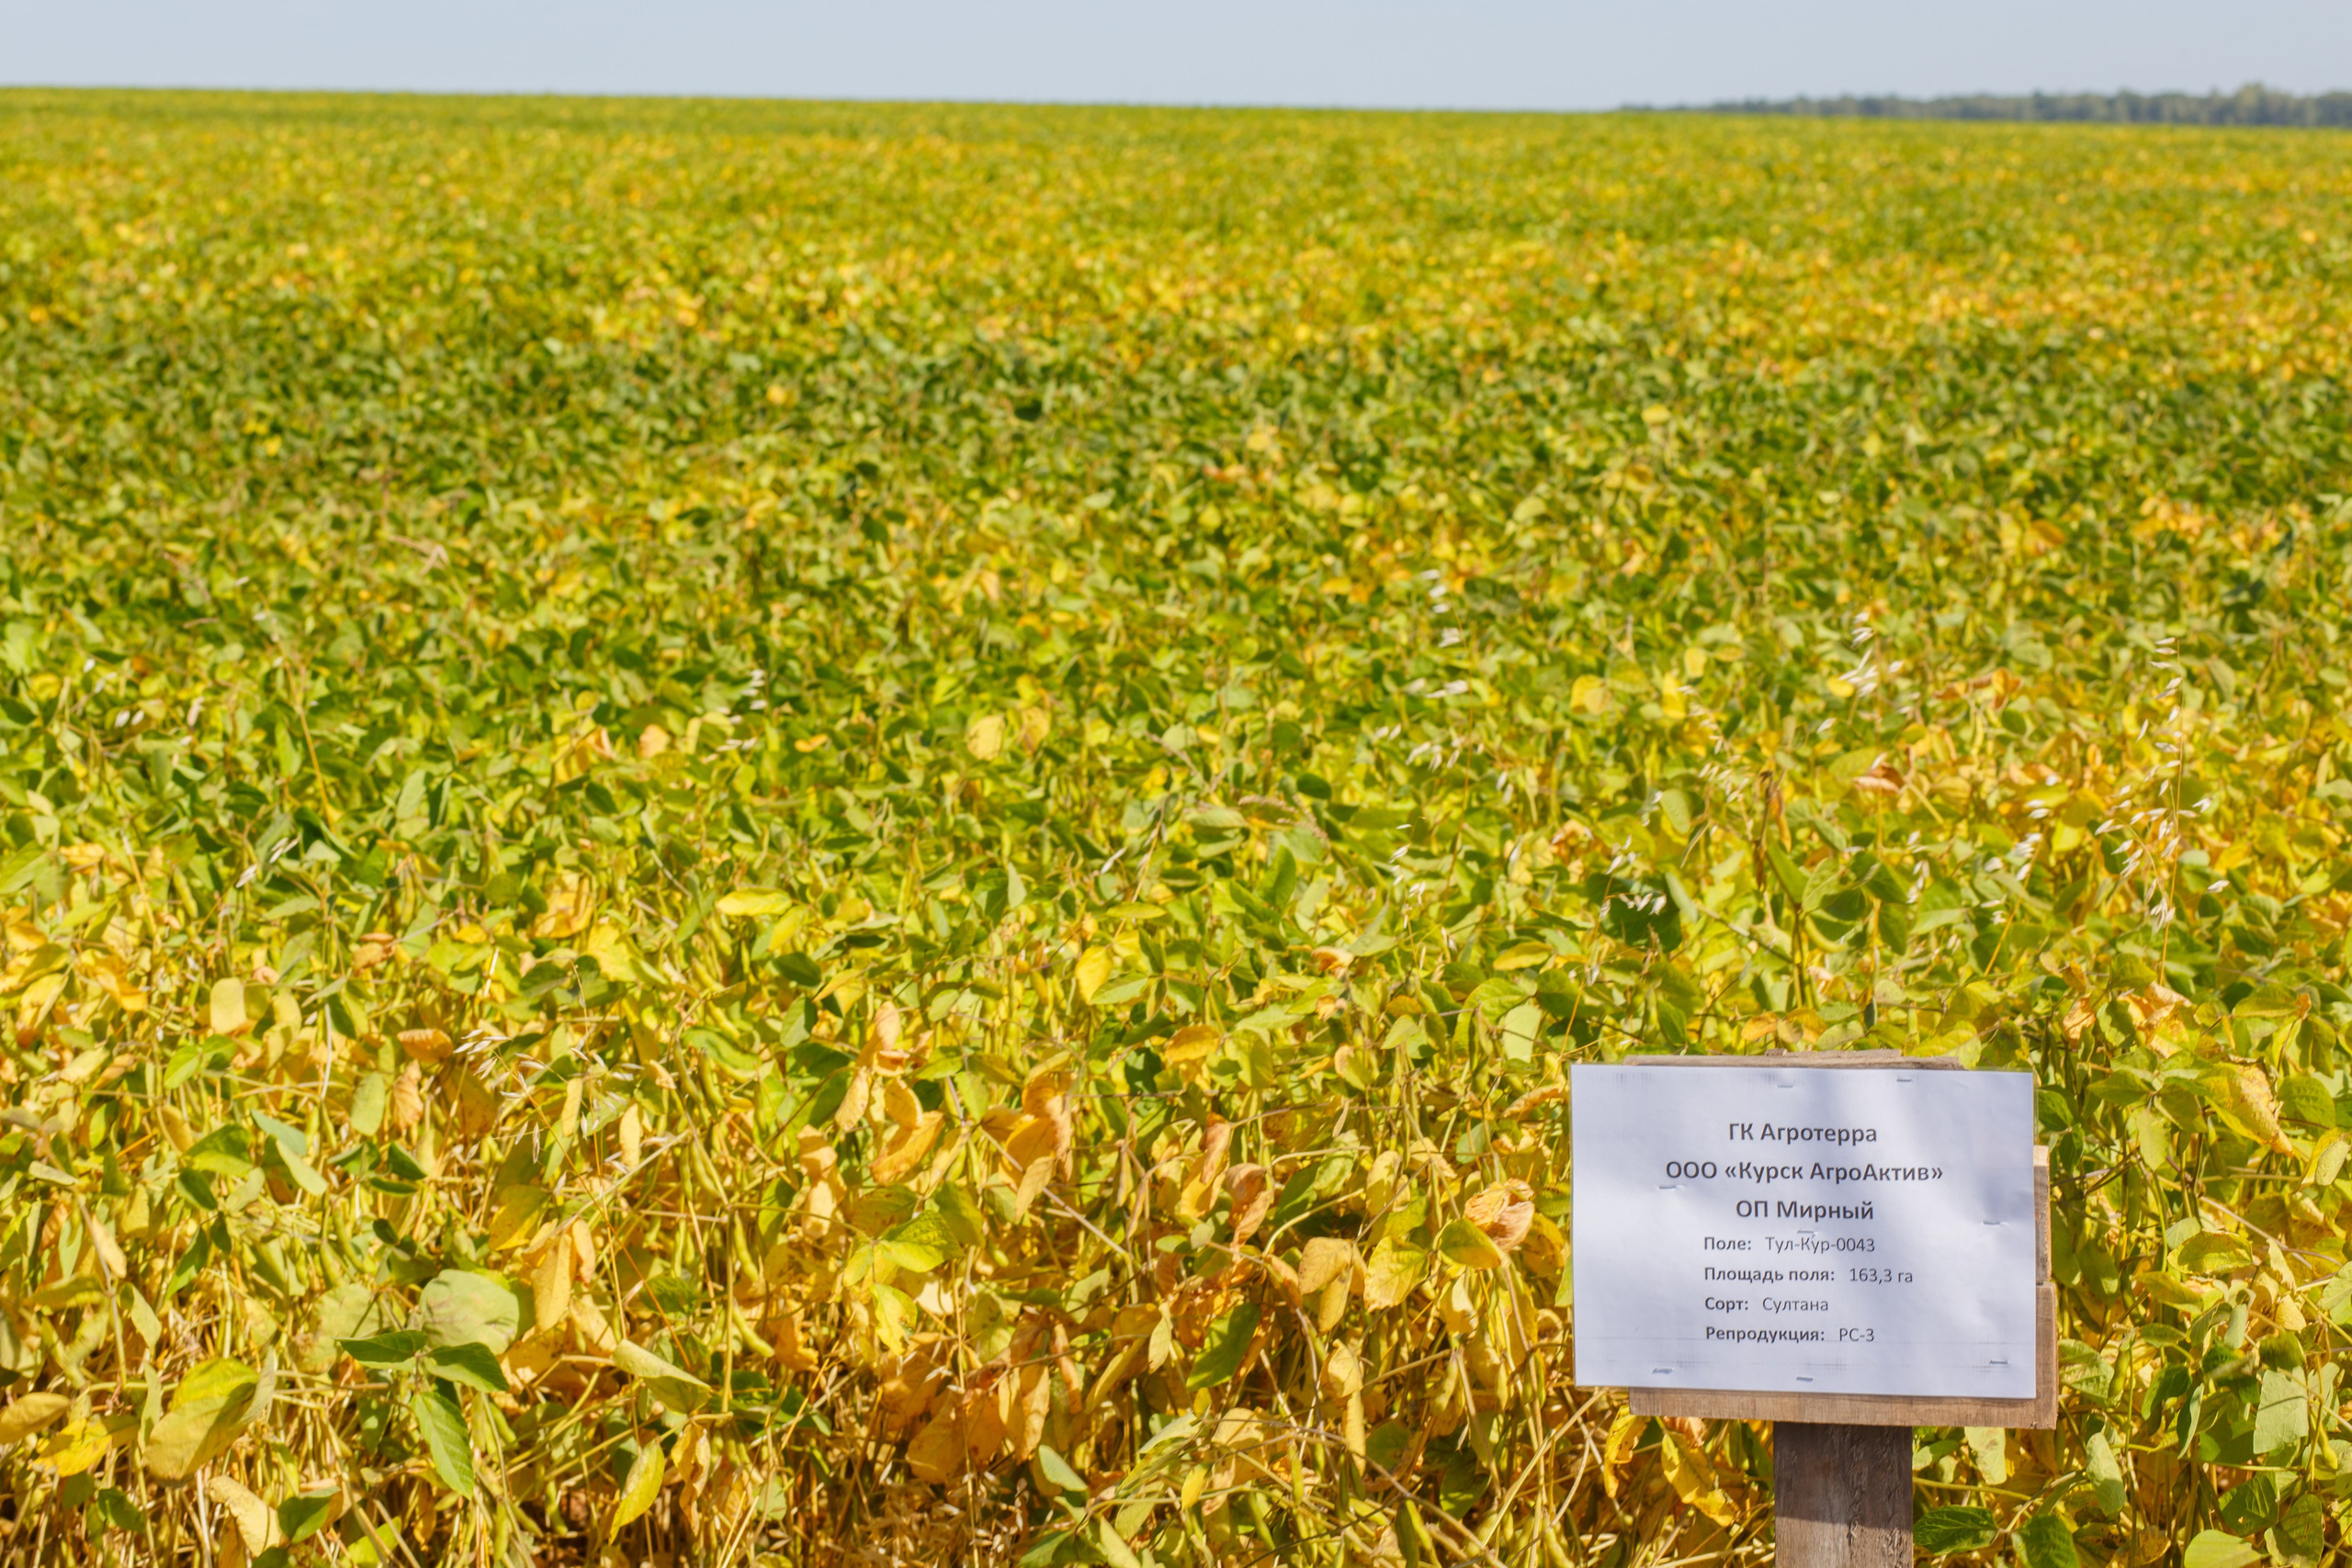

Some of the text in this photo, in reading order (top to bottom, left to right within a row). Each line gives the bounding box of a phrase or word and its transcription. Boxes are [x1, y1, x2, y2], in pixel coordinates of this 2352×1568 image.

[1728, 1122, 1877, 1145] ГК Агротерра
[1666, 1161, 1943, 1184] ООО «Курск АгроАктив»
[1736, 1201, 1874, 1222] ОП Мирный
[1704, 1236, 1875, 1254] Поле: Тул-Кур-0043
[1704, 1267, 1913, 1284] Площадь поля: 163,3 га
[1705, 1297, 1829, 1314] Сорт: Султана
[1706, 1326, 1875, 1343] Репродукция: РС-3
